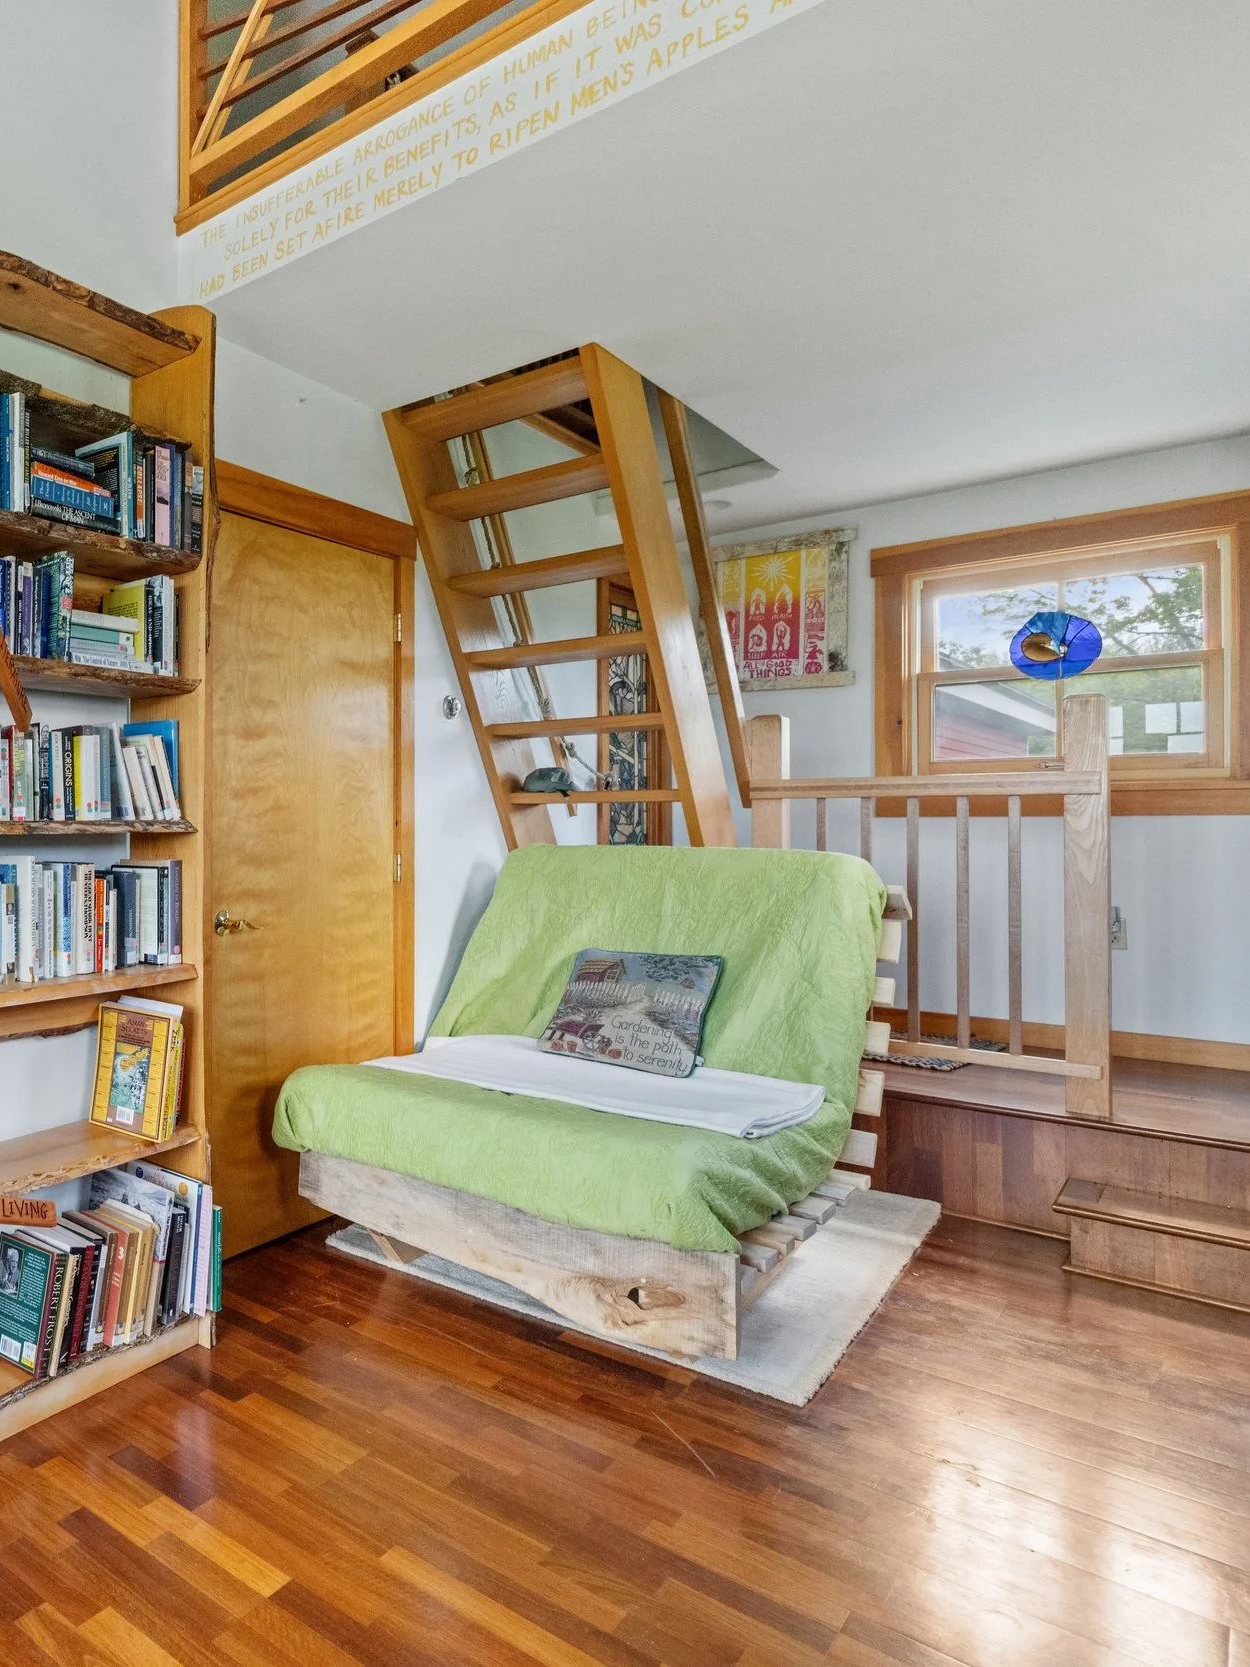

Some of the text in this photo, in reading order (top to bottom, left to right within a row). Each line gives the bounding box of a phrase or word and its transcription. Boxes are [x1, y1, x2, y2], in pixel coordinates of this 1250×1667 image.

[201, 0, 653, 248] THE INSUFFERABLE ARROGANCE OF HUMAN BEIN
[225, 13, 662, 261] SOLELY FOR THEIR BENEFITS, AS IF IT WAS
[199, 274, 225, 298] HAD
[233, 250, 268, 282] BEEN
[274, 230, 308, 261] SET
[312, 202, 365, 243] AFIRE
[373, 162, 444, 211] MERELY
[451, 147, 478, 172] TO
[490, 100, 560, 155] RIPEN
[570, 62, 635, 116] MEN'S
[647, 4, 749, 75] APPLES
[61, 513, 85, 525] OF MAN
[62, 506, 96, 520] THE ASCENT
[771, 613, 793, 621] HEALTH
[743, 660, 792, 669] ALL GOOD
[748, 667, 791, 679] THINGS
[65, 752, 73, 787] ORIGINS
[120, 1025, 148, 1036] SECRETS
[127, 1018, 144, 1028] ASIAN
[611, 1015, 672, 1043] Gardening
[614, 1035, 682, 1056] is the path
[622, 1046, 689, 1073] to serenity
[2, 1198, 49, 1219] LIVING
[162, 1226, 170, 1256] Photographer
[117, 1247, 125, 1260] 3
[71, 1251, 94, 1338] ELEANOR ROOSEVELT
[43, 1267, 65, 1353] ROBERT FROST
